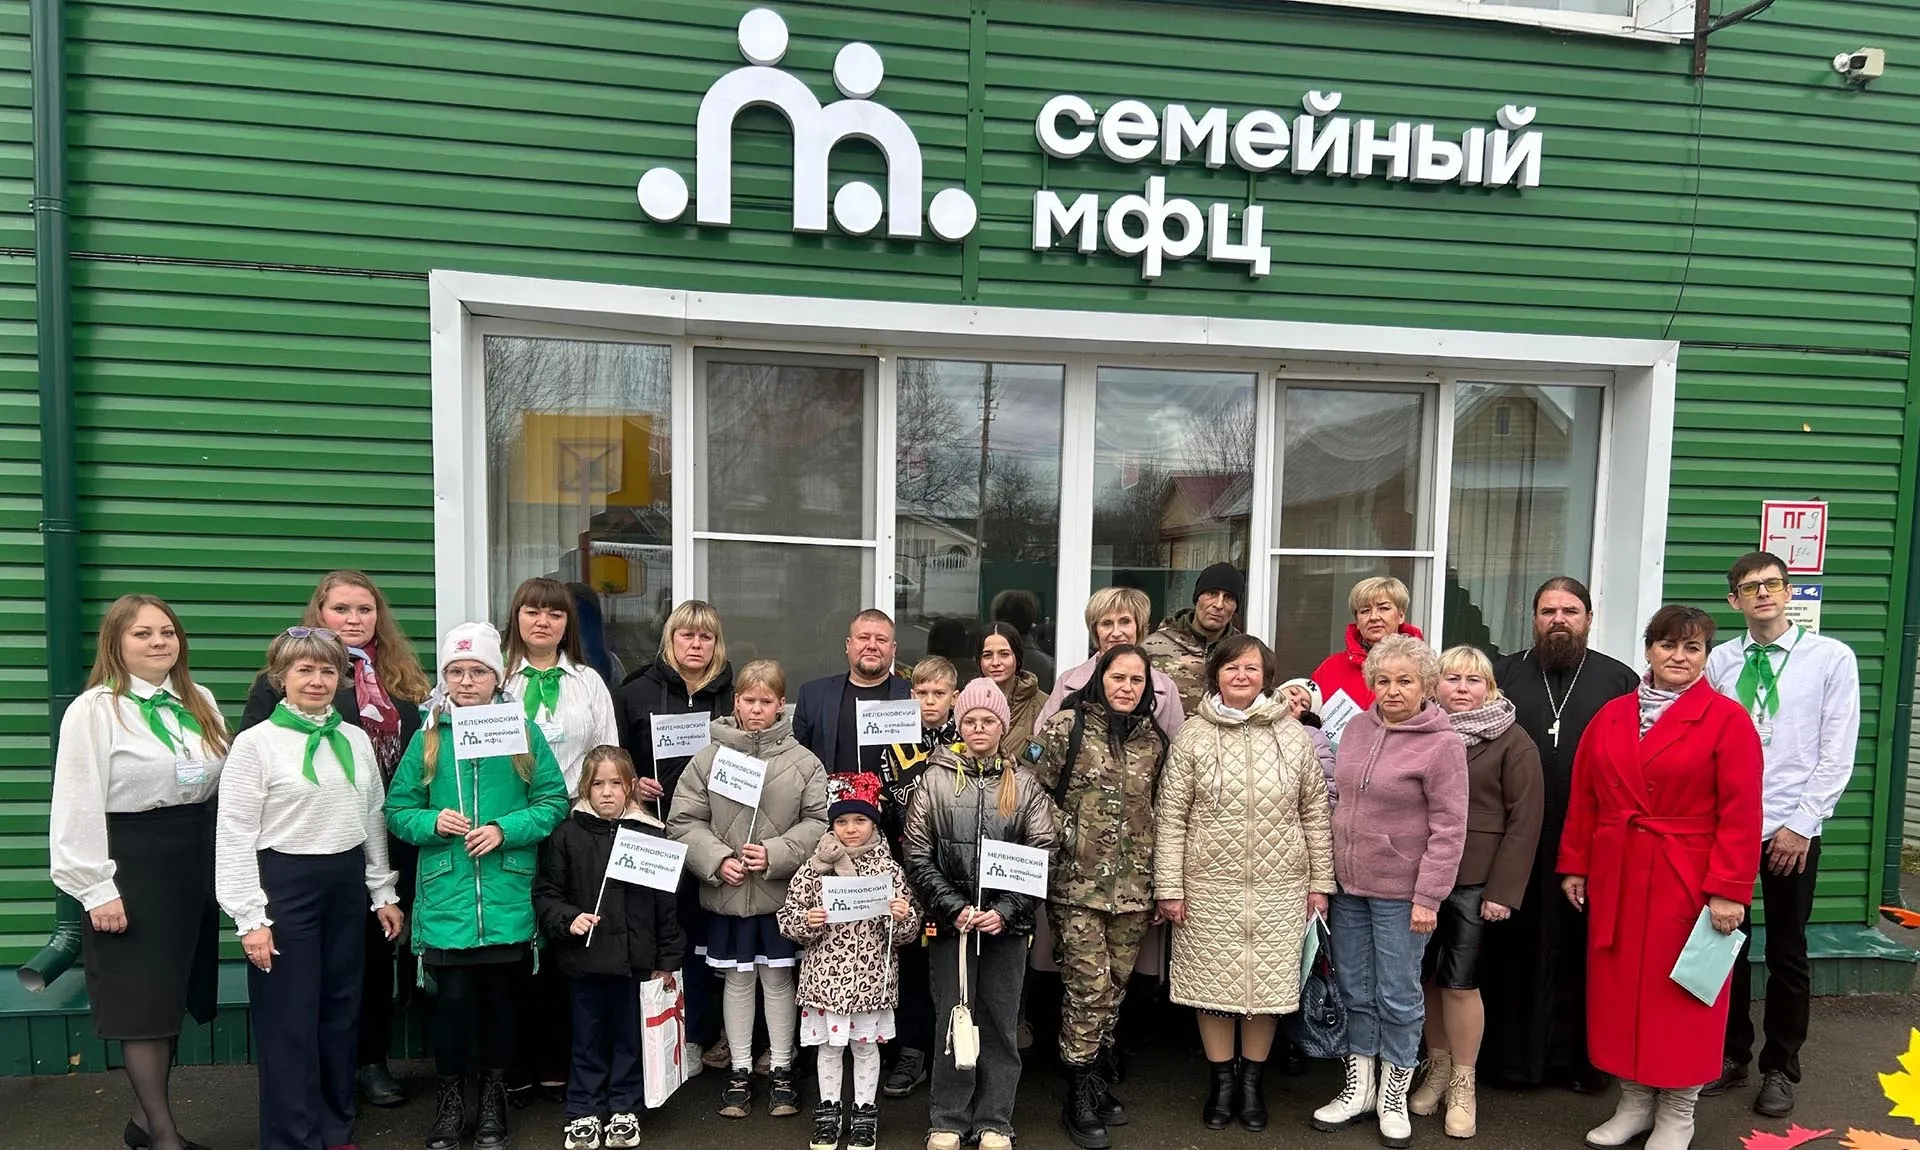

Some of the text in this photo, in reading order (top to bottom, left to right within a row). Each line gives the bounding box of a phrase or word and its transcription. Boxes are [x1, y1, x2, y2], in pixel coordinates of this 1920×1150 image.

[1035, 90, 1543, 189] семейный
[1033, 176, 1272, 280] мфц
[1783, 512, 1806, 529] ПГ
[458, 714, 519, 726] МЕЛЕНКОВСКИЙ
[863, 709, 916, 718] МЕЛЕНКОВСКИЙ
[881, 749, 893, 783] FILA
[619, 841, 680, 861] МЕЛЕНКОВСКИЙ
[988, 851, 1043, 867] МЕЛЕНКОВСКИЙ
[828, 884, 888, 894] МЕЛЕНКОВСКИЙ
